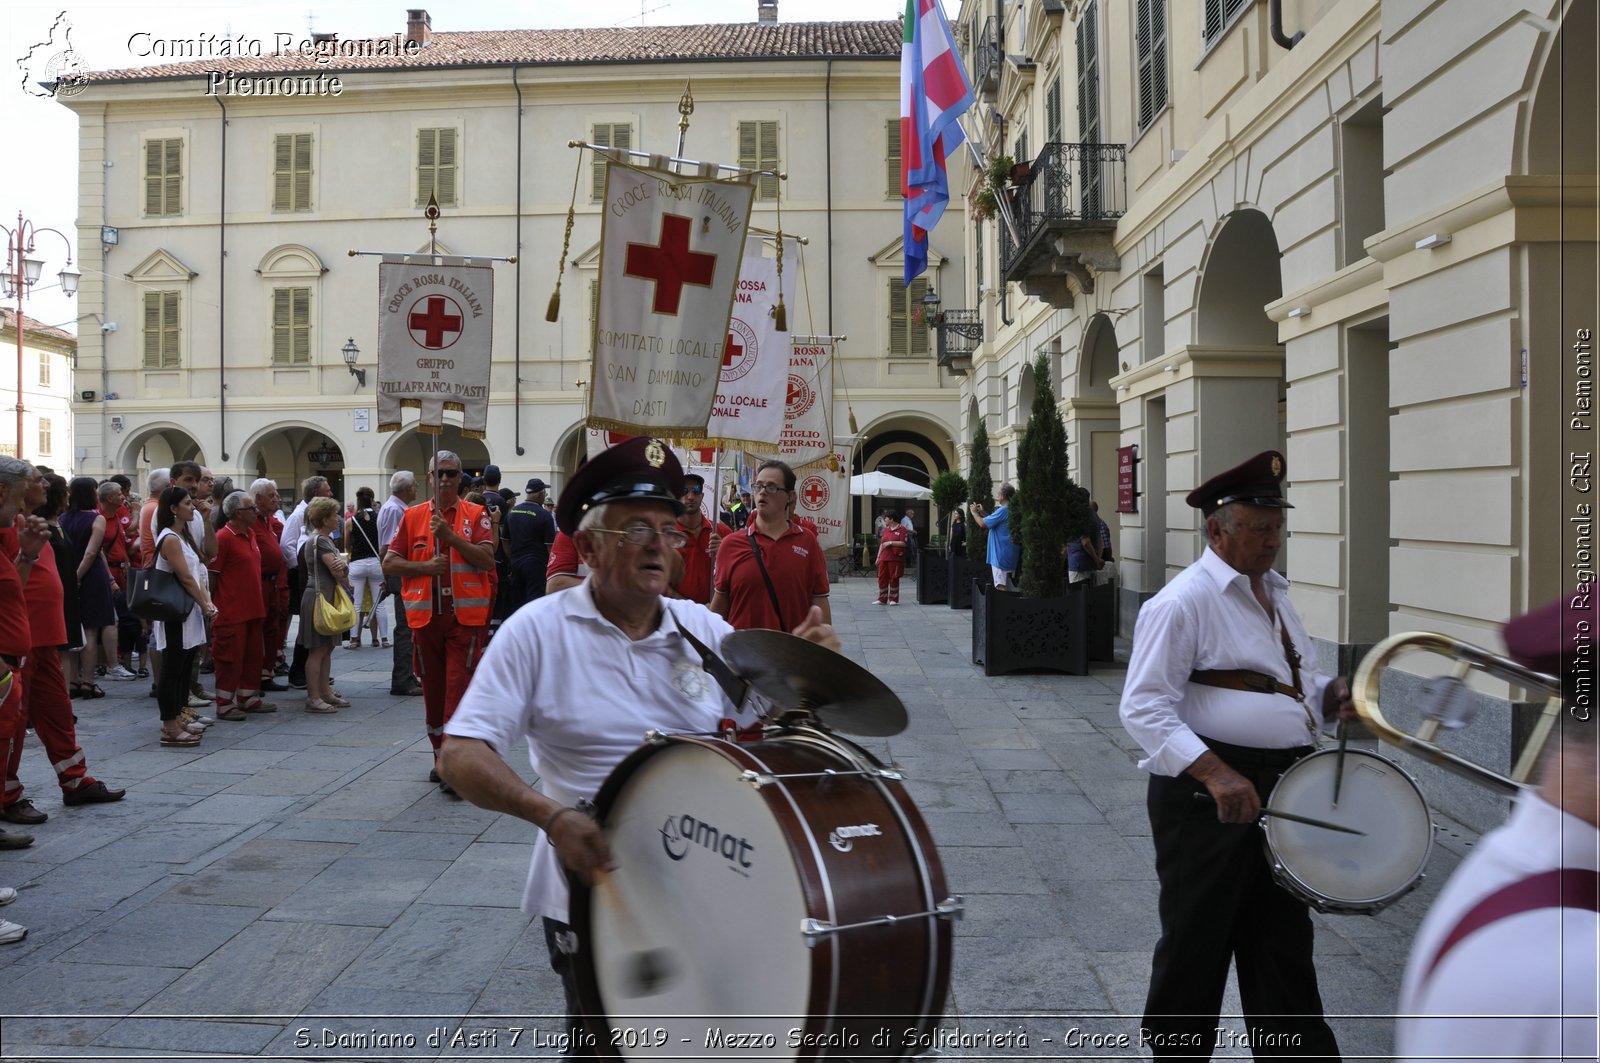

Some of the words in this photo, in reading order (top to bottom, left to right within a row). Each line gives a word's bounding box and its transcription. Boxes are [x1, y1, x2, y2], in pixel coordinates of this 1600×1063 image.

[611, 182, 650, 218] CROCE
[658, 181, 692, 200] ROSA
[697, 187, 742, 234] ITALIANA
[388, 283, 413, 314] CROCE
[413, 274, 445, 289] ROSSA
[449, 277, 485, 319] ITALIANA
[598, 329, 663, 354] COMITATO
[670, 338, 721, 359] LOCALE
[793, 347, 826, 356] ROSSA
[416, 358, 455, 370] GRUPPO
[789, 358, 814, 367] IANA
[431, 371, 440, 379] DI
[608, 363, 637, 382] SAN
[647, 369, 702, 388] DAMIANO
[380, 381, 451, 394] VILLAFRANCA
[454, 384, 487, 398] D'ASTI
[633, 399, 667, 416] D'ASTI
[730, 395, 768, 408] LOCALE
[711, 407, 740, 418] ONALE
[781, 430, 820, 439] TIGLIO
[778, 439, 826, 449] FERRATO
[817, 517, 842, 527] LOCALE
[679, 814, 754, 868] amat
